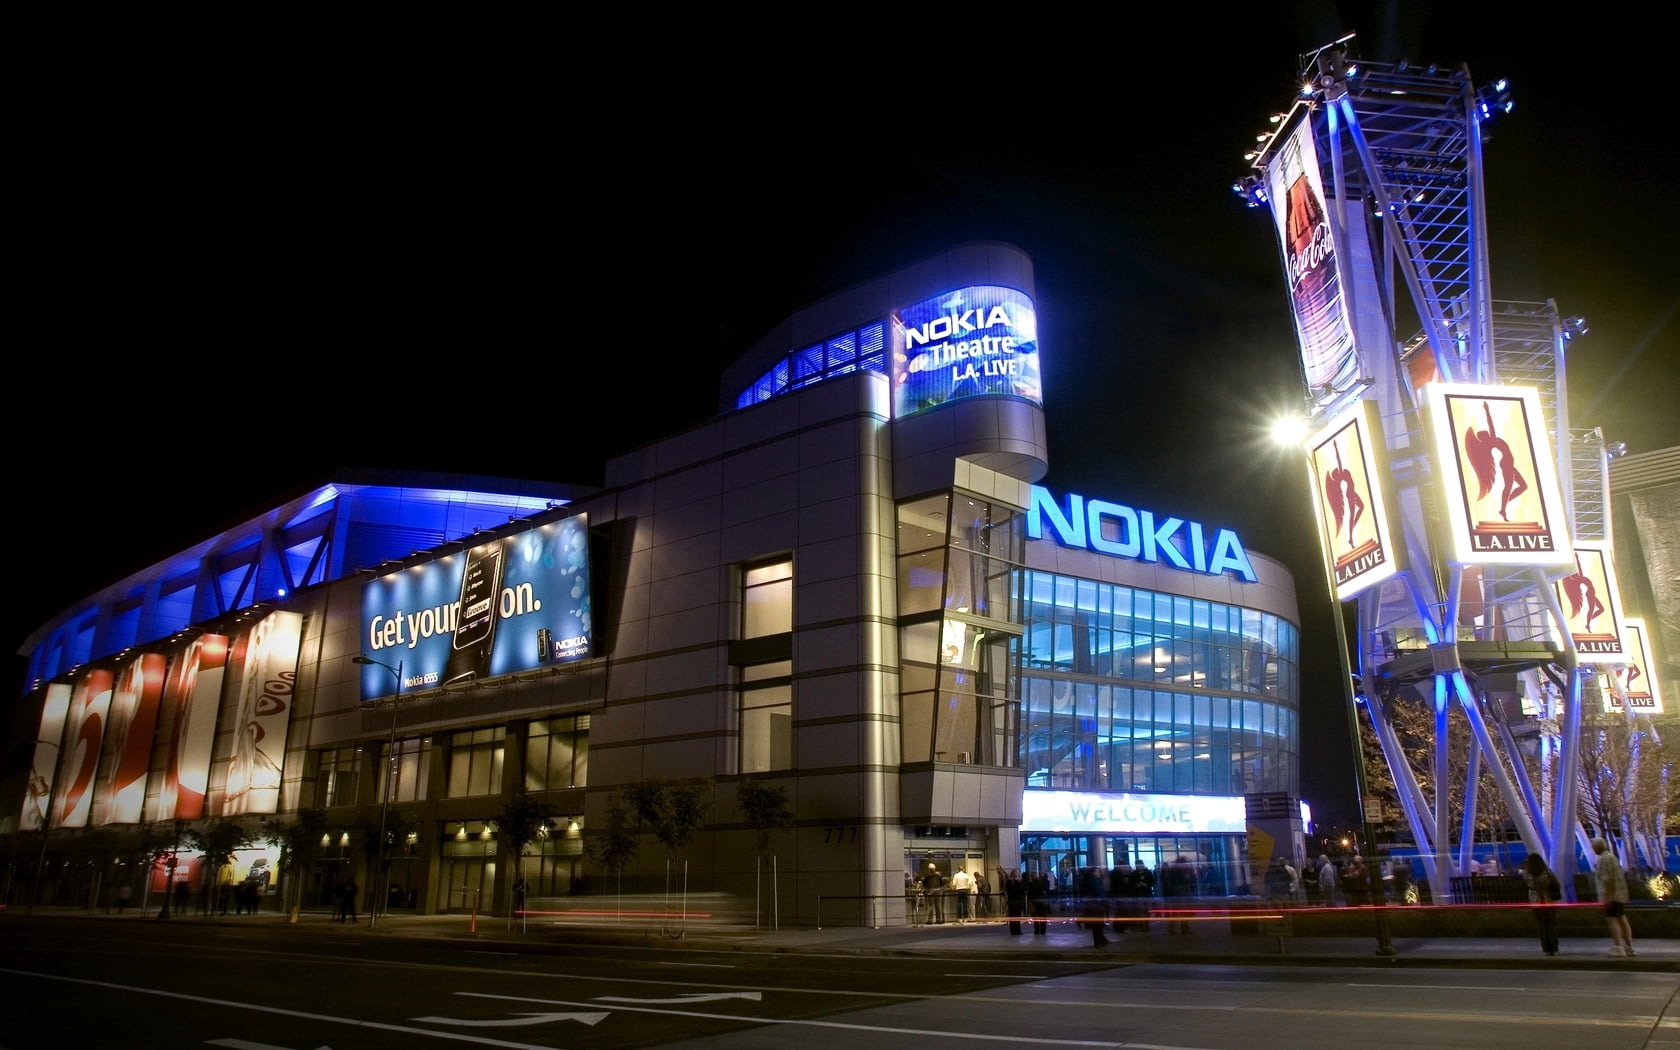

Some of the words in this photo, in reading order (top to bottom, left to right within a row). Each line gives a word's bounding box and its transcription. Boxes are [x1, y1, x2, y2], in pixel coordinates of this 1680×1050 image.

[906, 306, 1013, 349] NOKIA
[930, 335, 1015, 366] Theatre
[953, 363, 980, 381] L.A.
[984, 359, 1017, 377] LIVE
[1026, 484, 1258, 582] NOKIA
[1472, 534, 1507, 549] L.A.
[1507, 534, 1552, 549] LIVE
[1335, 565, 1356, 585] L.A.
[1354, 548, 1383, 575] LIVE
[370, 610, 405, 650] Get
[408, 599, 461, 649] your
[500, 581, 541, 619] on.
[555, 635, 588, 650] NOKIA
[1591, 641, 1620, 652] LIVE
[404, 675, 423, 688] Nokia
[1630, 697, 1655, 706] LIVE
[1068, 801, 1193, 823] WELCOME
[824, 827, 857, 844] 777
